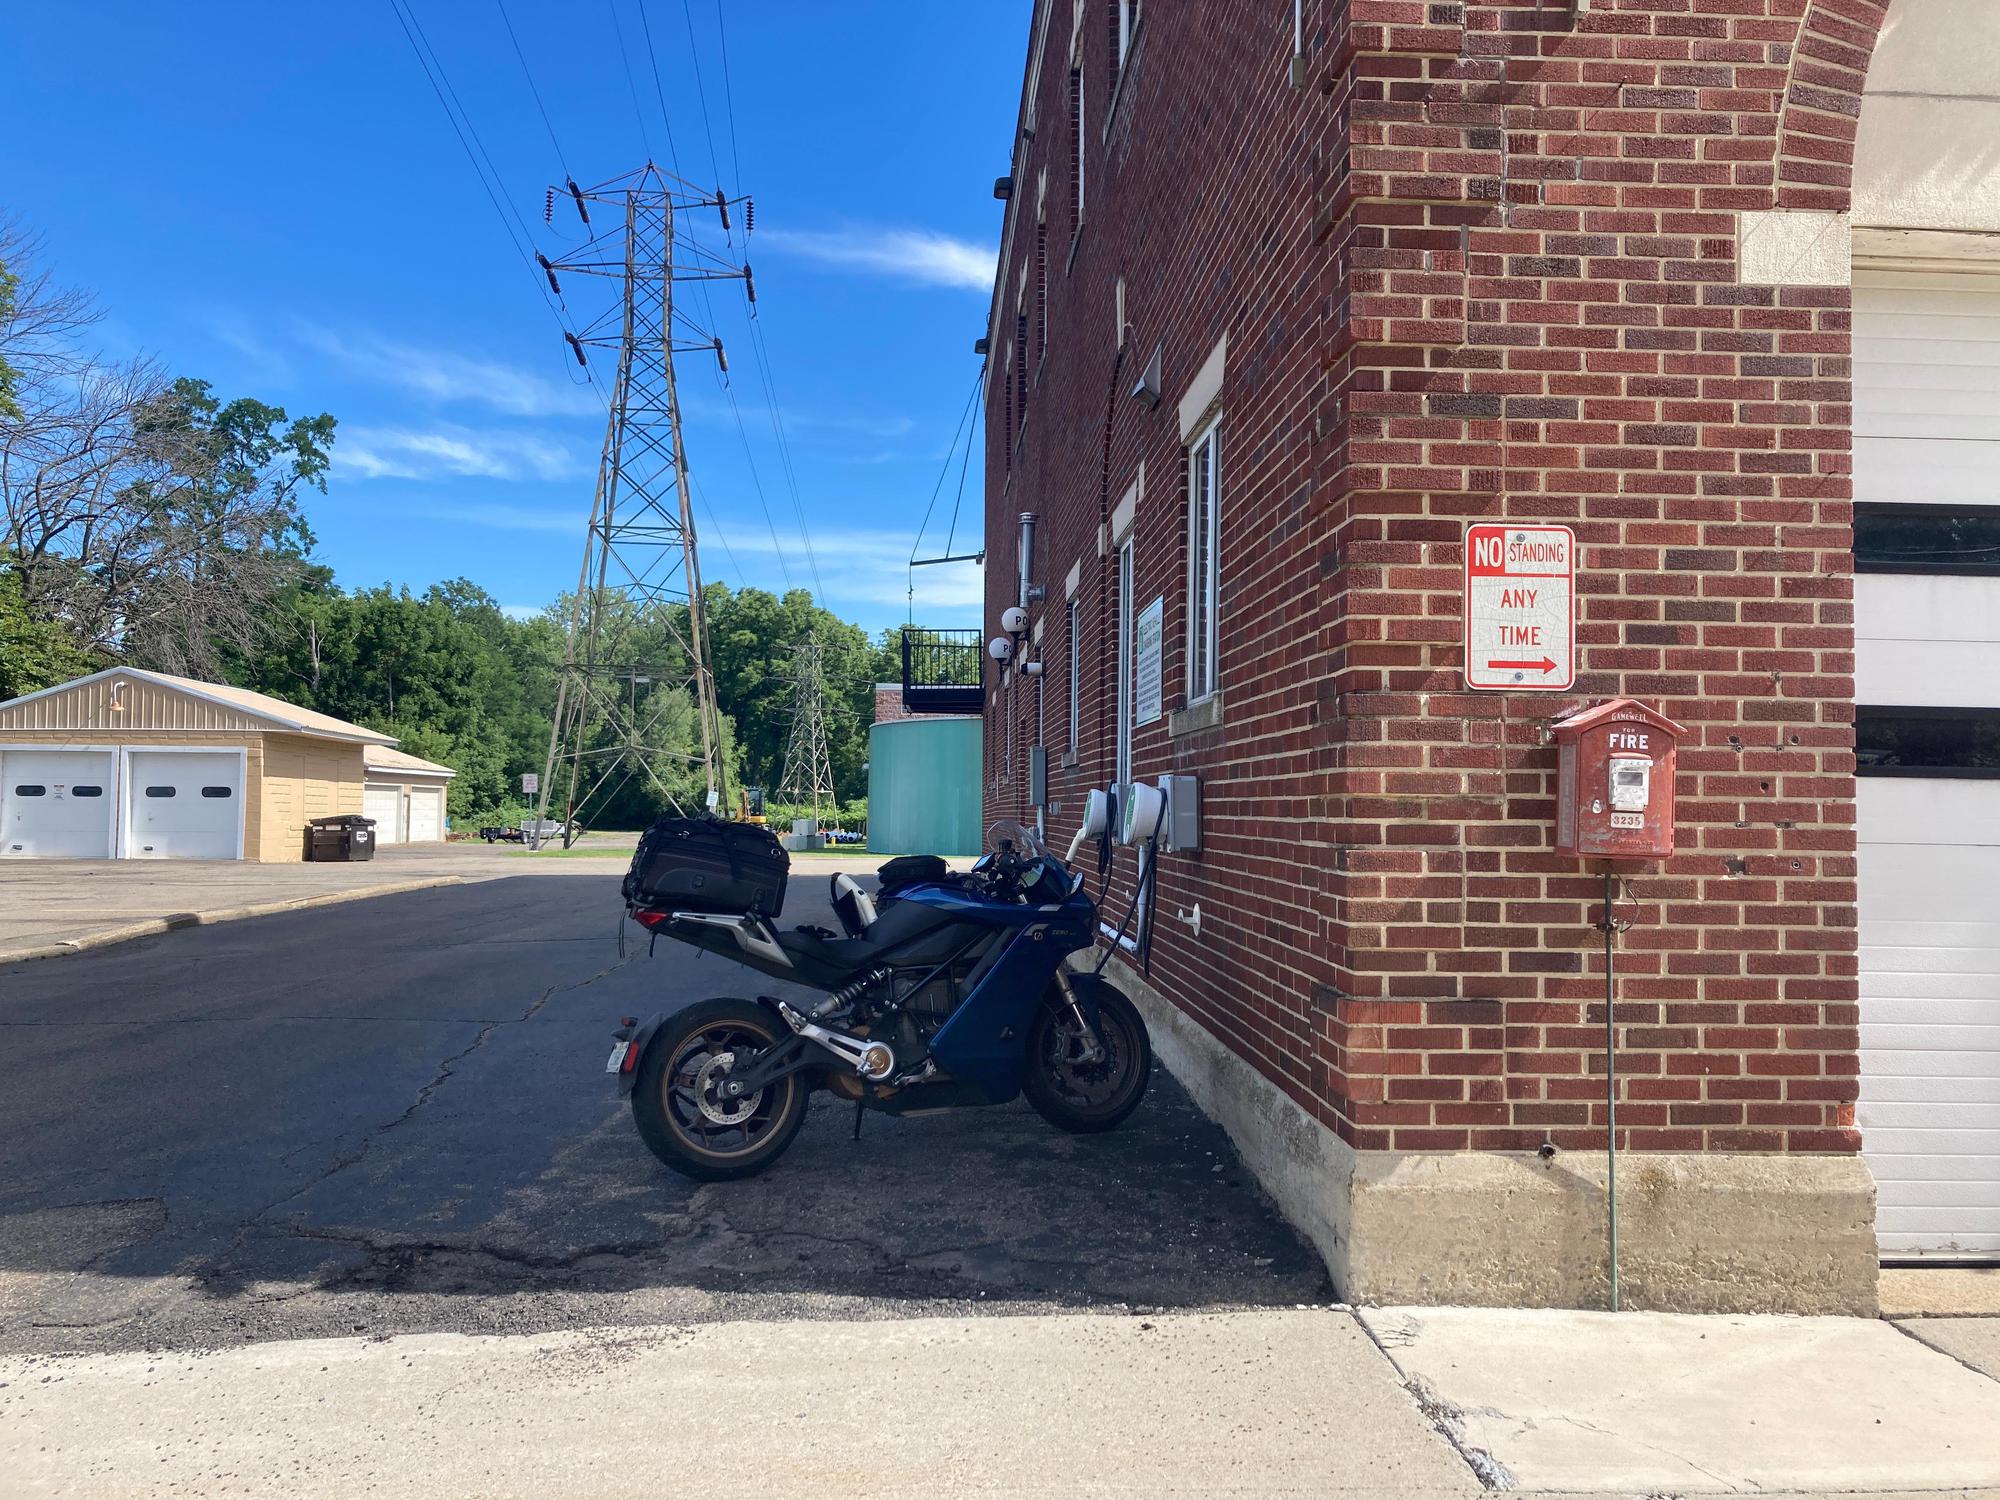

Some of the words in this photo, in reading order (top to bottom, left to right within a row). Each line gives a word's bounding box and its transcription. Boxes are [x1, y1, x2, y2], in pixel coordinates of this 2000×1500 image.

[1475, 536, 1503, 568] NO
[1509, 543, 1564, 563] STANDING
[1501, 589, 1538, 608] ANY
[1499, 626, 1541, 645] TIME
[1609, 733, 1649, 749] FIRE
[1613, 816, 1641, 825] 3235
